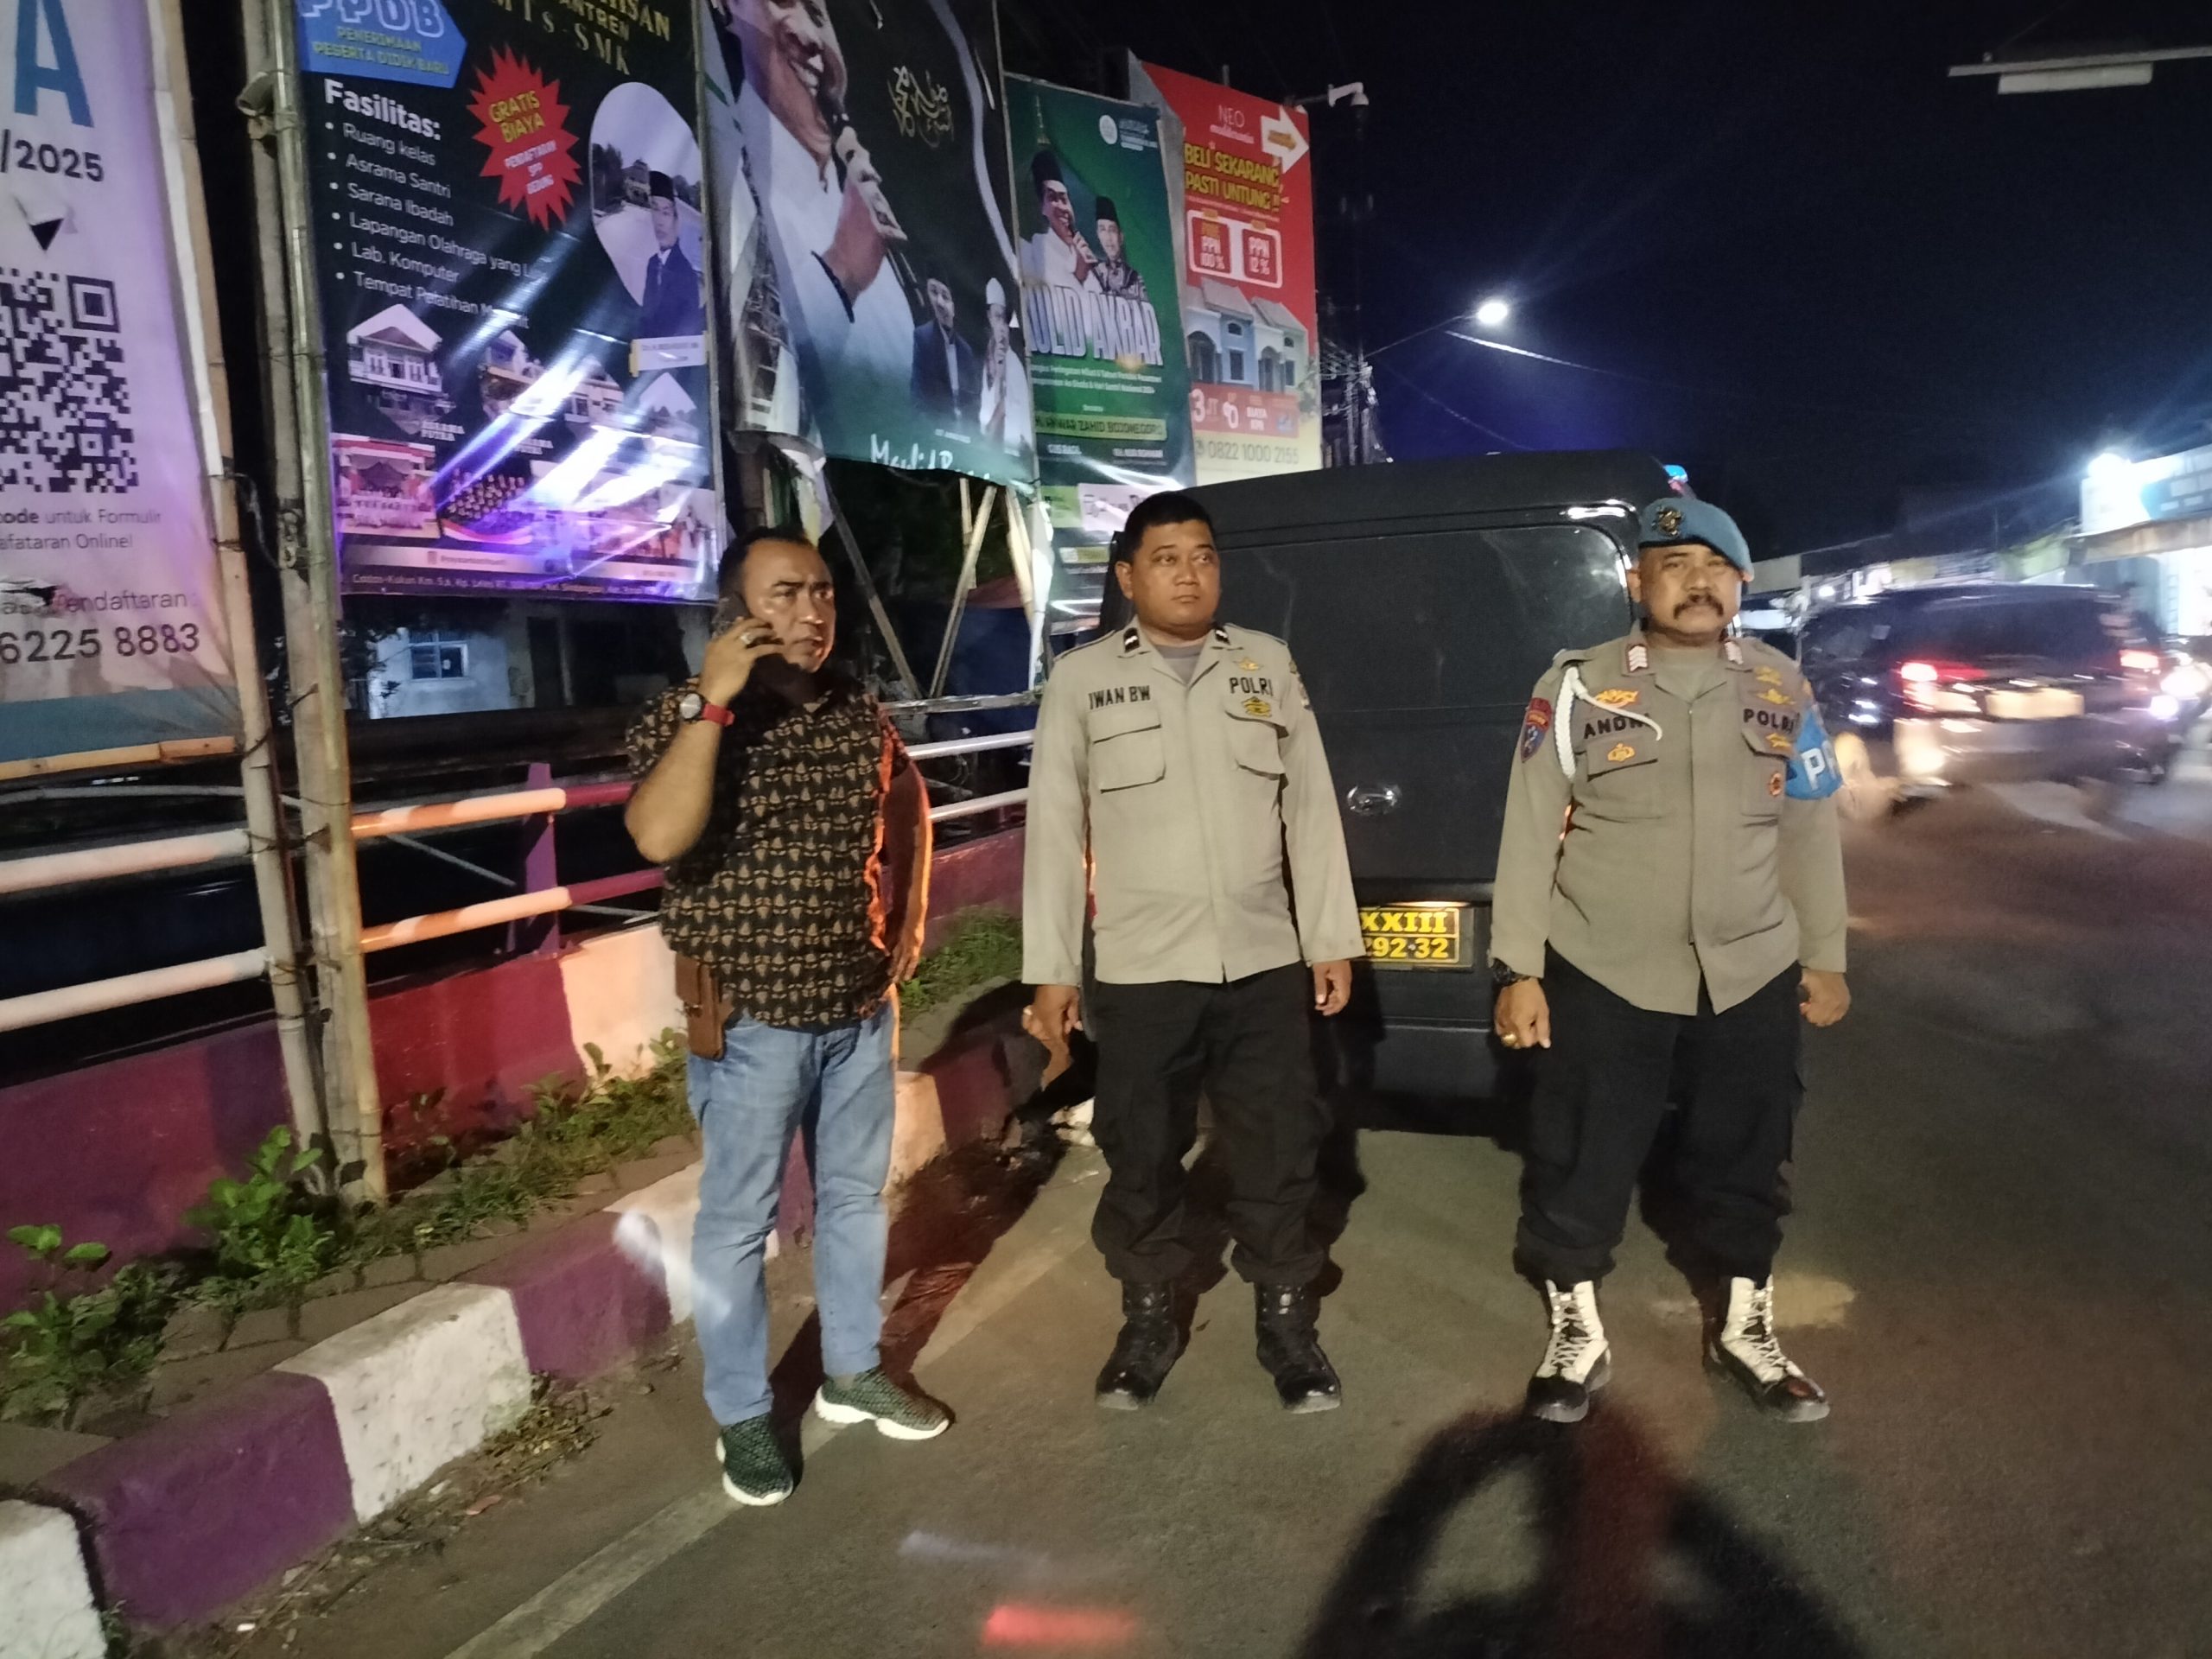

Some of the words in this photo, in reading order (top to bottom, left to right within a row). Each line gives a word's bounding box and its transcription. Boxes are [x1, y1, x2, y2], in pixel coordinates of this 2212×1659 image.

[324, 78, 442, 141] Fasilitas:
[489, 90, 540, 123] GRATIS
[1218, 104, 1245, 128] NEO
[500, 112, 545, 143] BIAYA
[342, 122, 397, 156] Ruang
[397, 140, 436, 166] kelas
[346, 153, 407, 185] Asrama
[409, 172, 451, 199] Santri
[1185, 170, 1219, 197] PASTI
[347, 181, 403, 212] Sarana
[404, 199, 454, 226] Ibadah
[349, 212, 425, 246] Lapangan
[428, 233, 488, 265] Olahraga
[489, 255, 523, 277] yang
[351, 241, 386, 264] Lab.
[388, 251, 461, 283] Komputer
[353, 270, 414, 299] Tempat
[1208, 441, 1240, 461] 0822
[46, 509, 91, 524] untuk
[113, 622, 200, 658] 8883
[1088, 688, 1125, 710] IWAN
[1128, 685, 1151, 702] BW
[1229, 677, 1274, 697] POLRI
